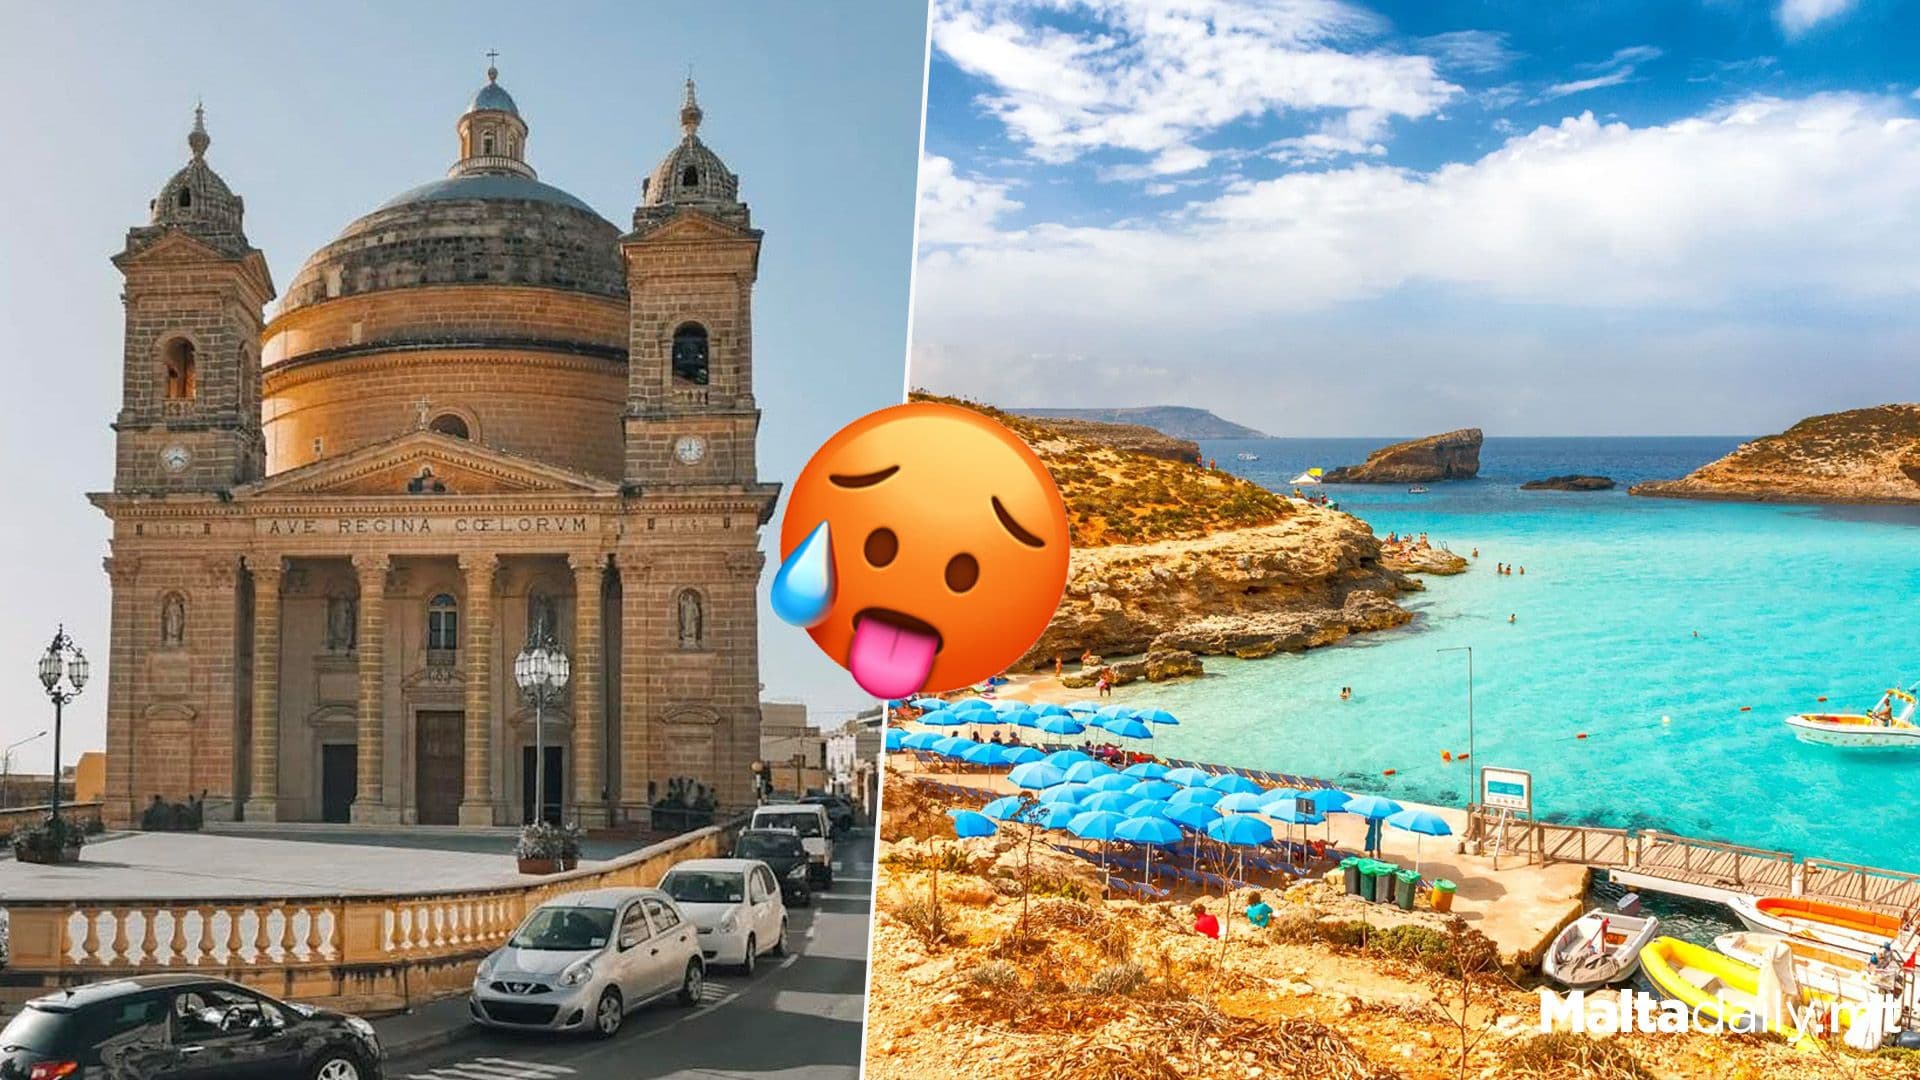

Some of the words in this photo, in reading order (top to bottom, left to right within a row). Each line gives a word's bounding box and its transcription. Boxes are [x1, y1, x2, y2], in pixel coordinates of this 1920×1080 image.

[269, 519, 317, 534] AVE
[338, 518, 431, 534] REGINA
[455, 517, 586, 532] CŒLORVM
